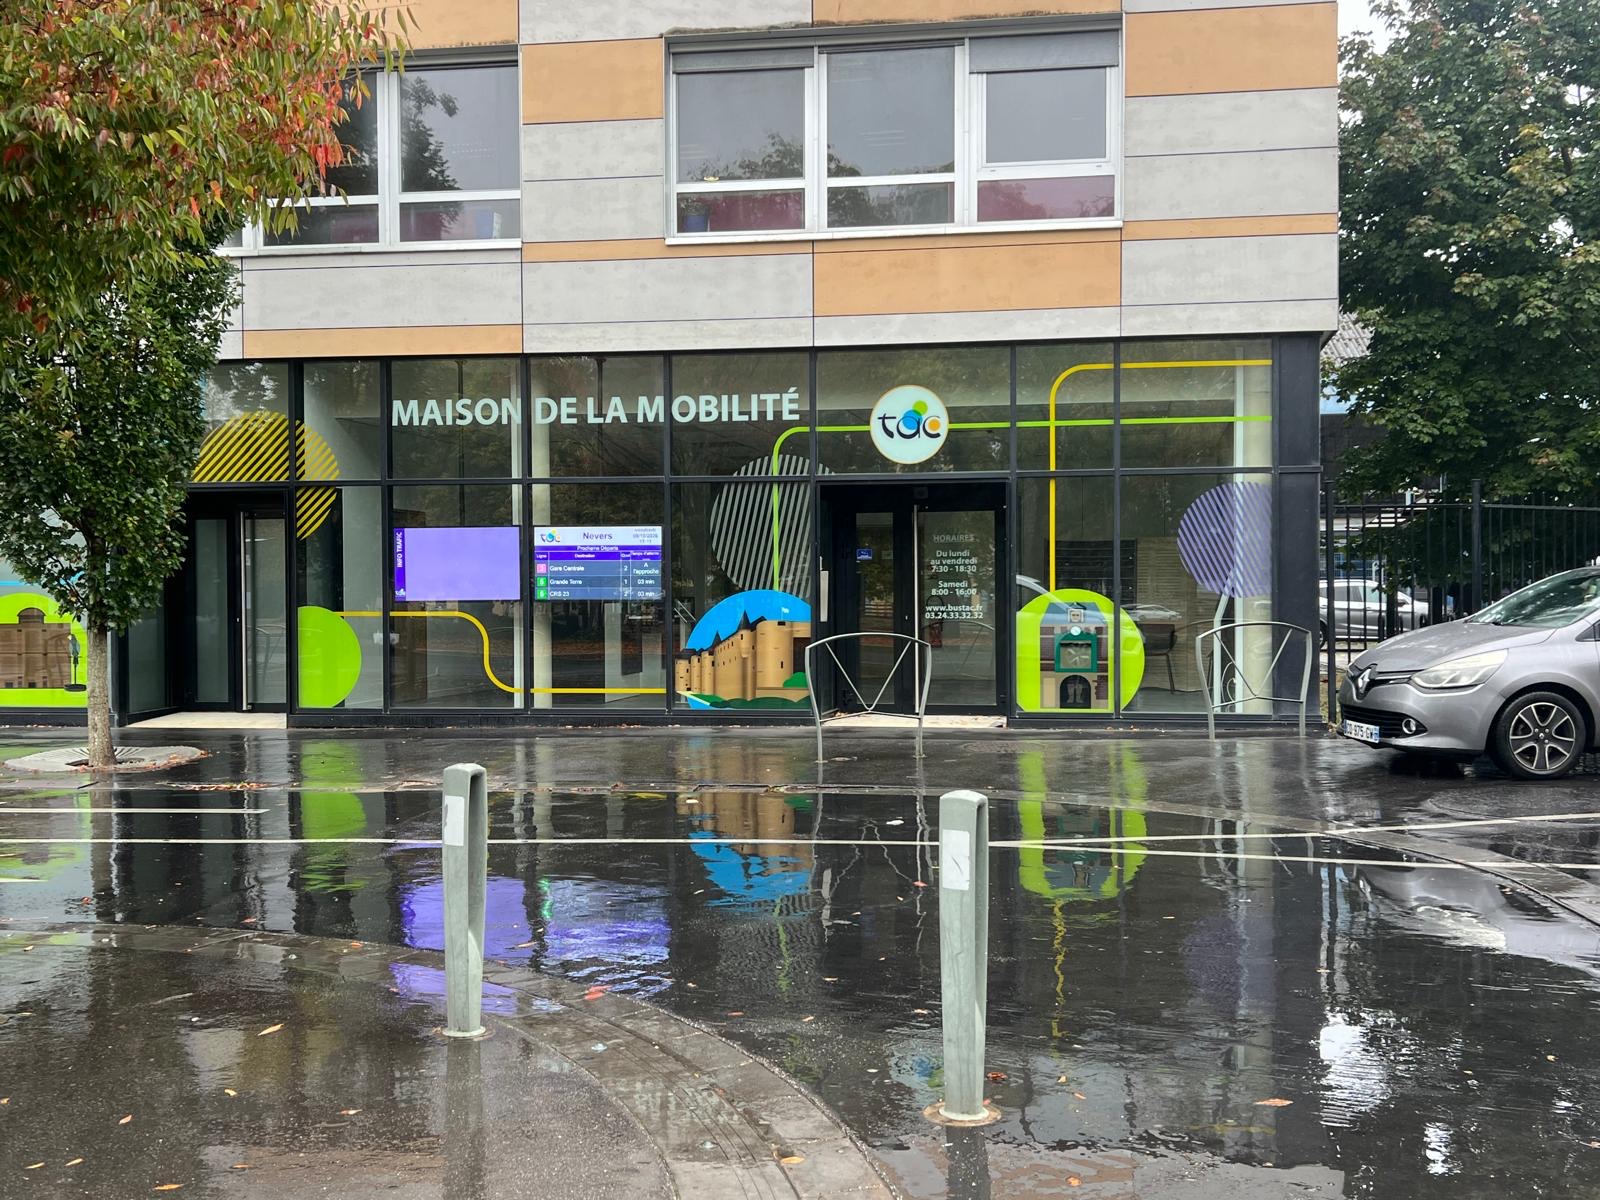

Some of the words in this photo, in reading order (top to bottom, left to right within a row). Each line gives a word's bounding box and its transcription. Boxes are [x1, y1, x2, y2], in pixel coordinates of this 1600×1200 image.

[391, 398, 521, 428] MAISON
[535, 396, 577, 425] DE
[586, 396, 627, 425] LA
[637, 387, 800, 423] MOBILITÉ
[877, 413, 941, 439] tac
[933, 534, 975, 543] HORAIRES
[949, 549, 970, 557] lundi
[942, 557, 978, 565] vendredi
[931, 565, 949, 573] 7:30
[955, 565, 977, 573] 18:30
[938, 580, 968, 588] Samedi
[931, 588, 949, 596] 8:00
[955, 588, 977, 596] 16:00
